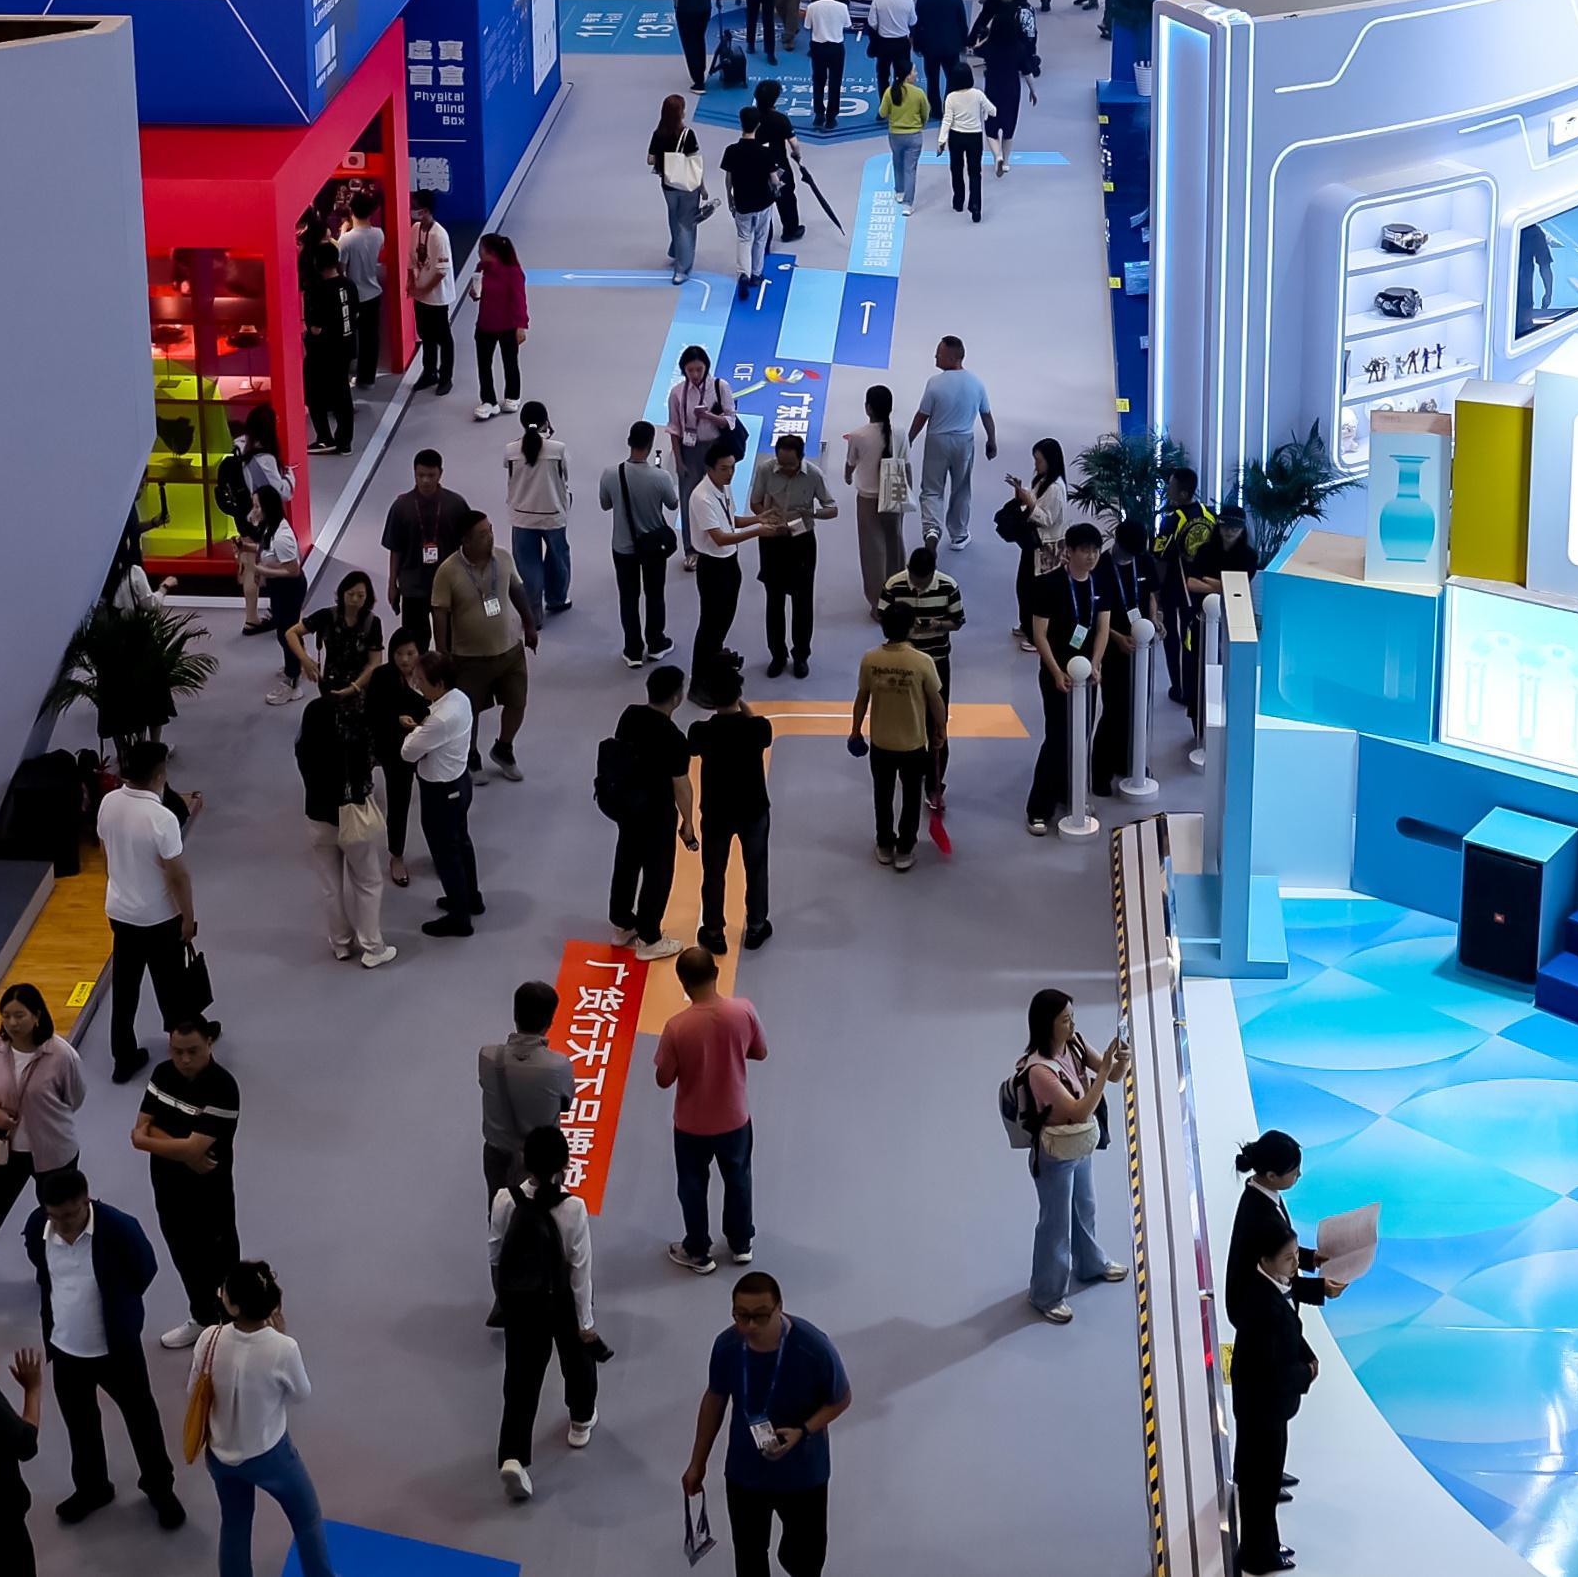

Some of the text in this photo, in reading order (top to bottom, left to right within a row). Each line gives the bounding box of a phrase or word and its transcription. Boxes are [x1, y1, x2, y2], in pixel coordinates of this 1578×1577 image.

[414, 91, 464, 103] Phygital
[435, 104, 465, 114] Blind
[442, 116, 465, 126] Box
[733, 363, 755, 382] ICIF
